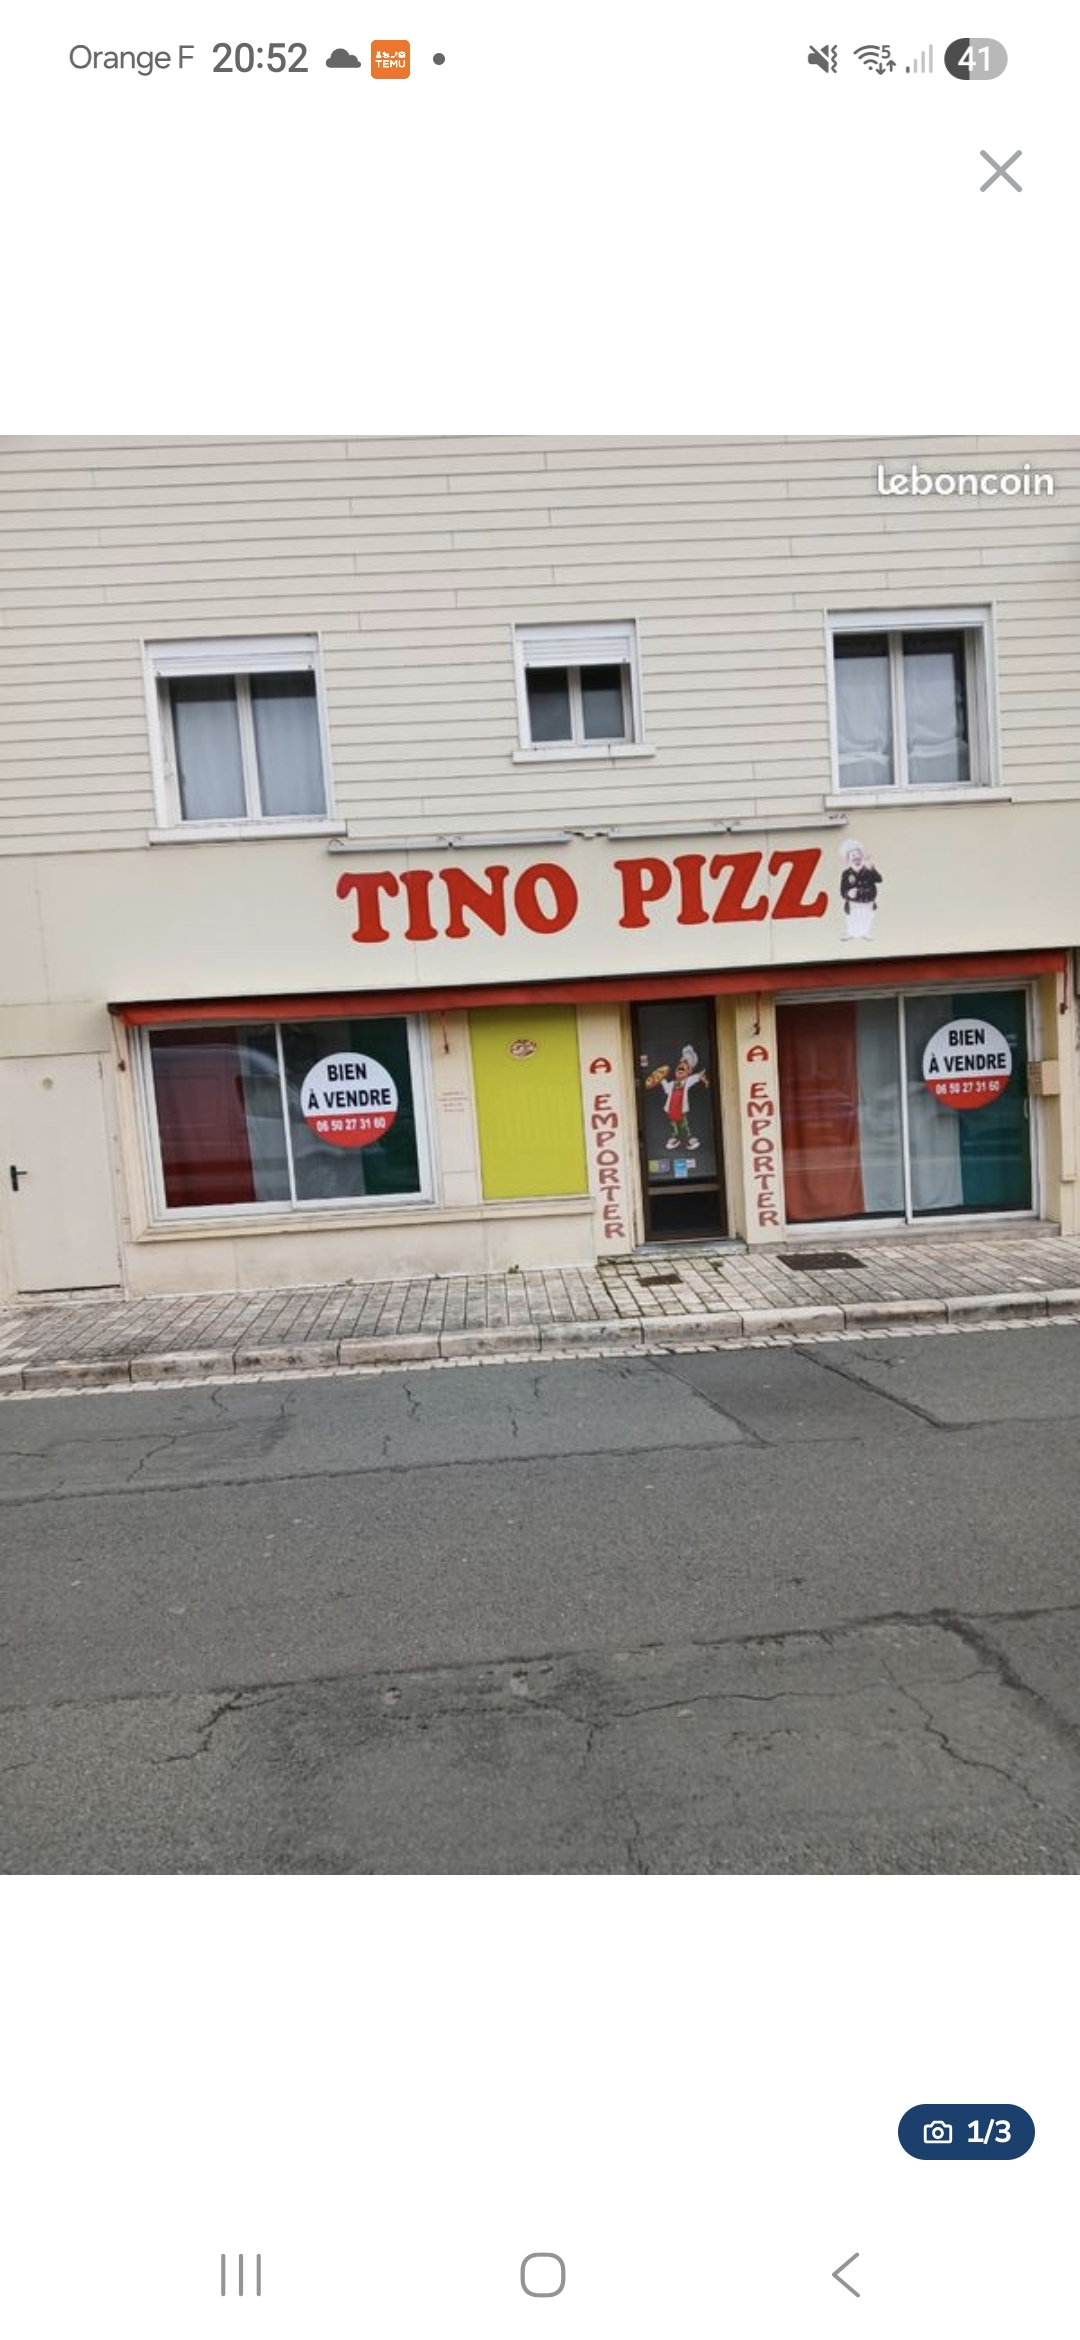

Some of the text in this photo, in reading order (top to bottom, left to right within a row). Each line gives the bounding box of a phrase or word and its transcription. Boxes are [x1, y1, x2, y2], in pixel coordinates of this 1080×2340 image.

[336, 848, 829, 944] TINO PIZZ
[948, 1028, 986, 1046] BIEN
[327, 1063, 367, 1082] BIEN
[928, 1052, 1007, 1074] À VENDRE
[935, 1081, 948, 1095] 06
[962, 1081, 973, 1093] 27
[976, 1080, 987, 1092] 31
[988, 1080, 1000, 1091] 60
[308, 1088, 392, 1110] À VENDRE
[345, 1118, 358, 1130] 27
[360, 1117, 372, 1129] 31
[746, 1045, 780, 1228] A EMPORTER
[589, 1057, 627, 1240] A EMPORTER
